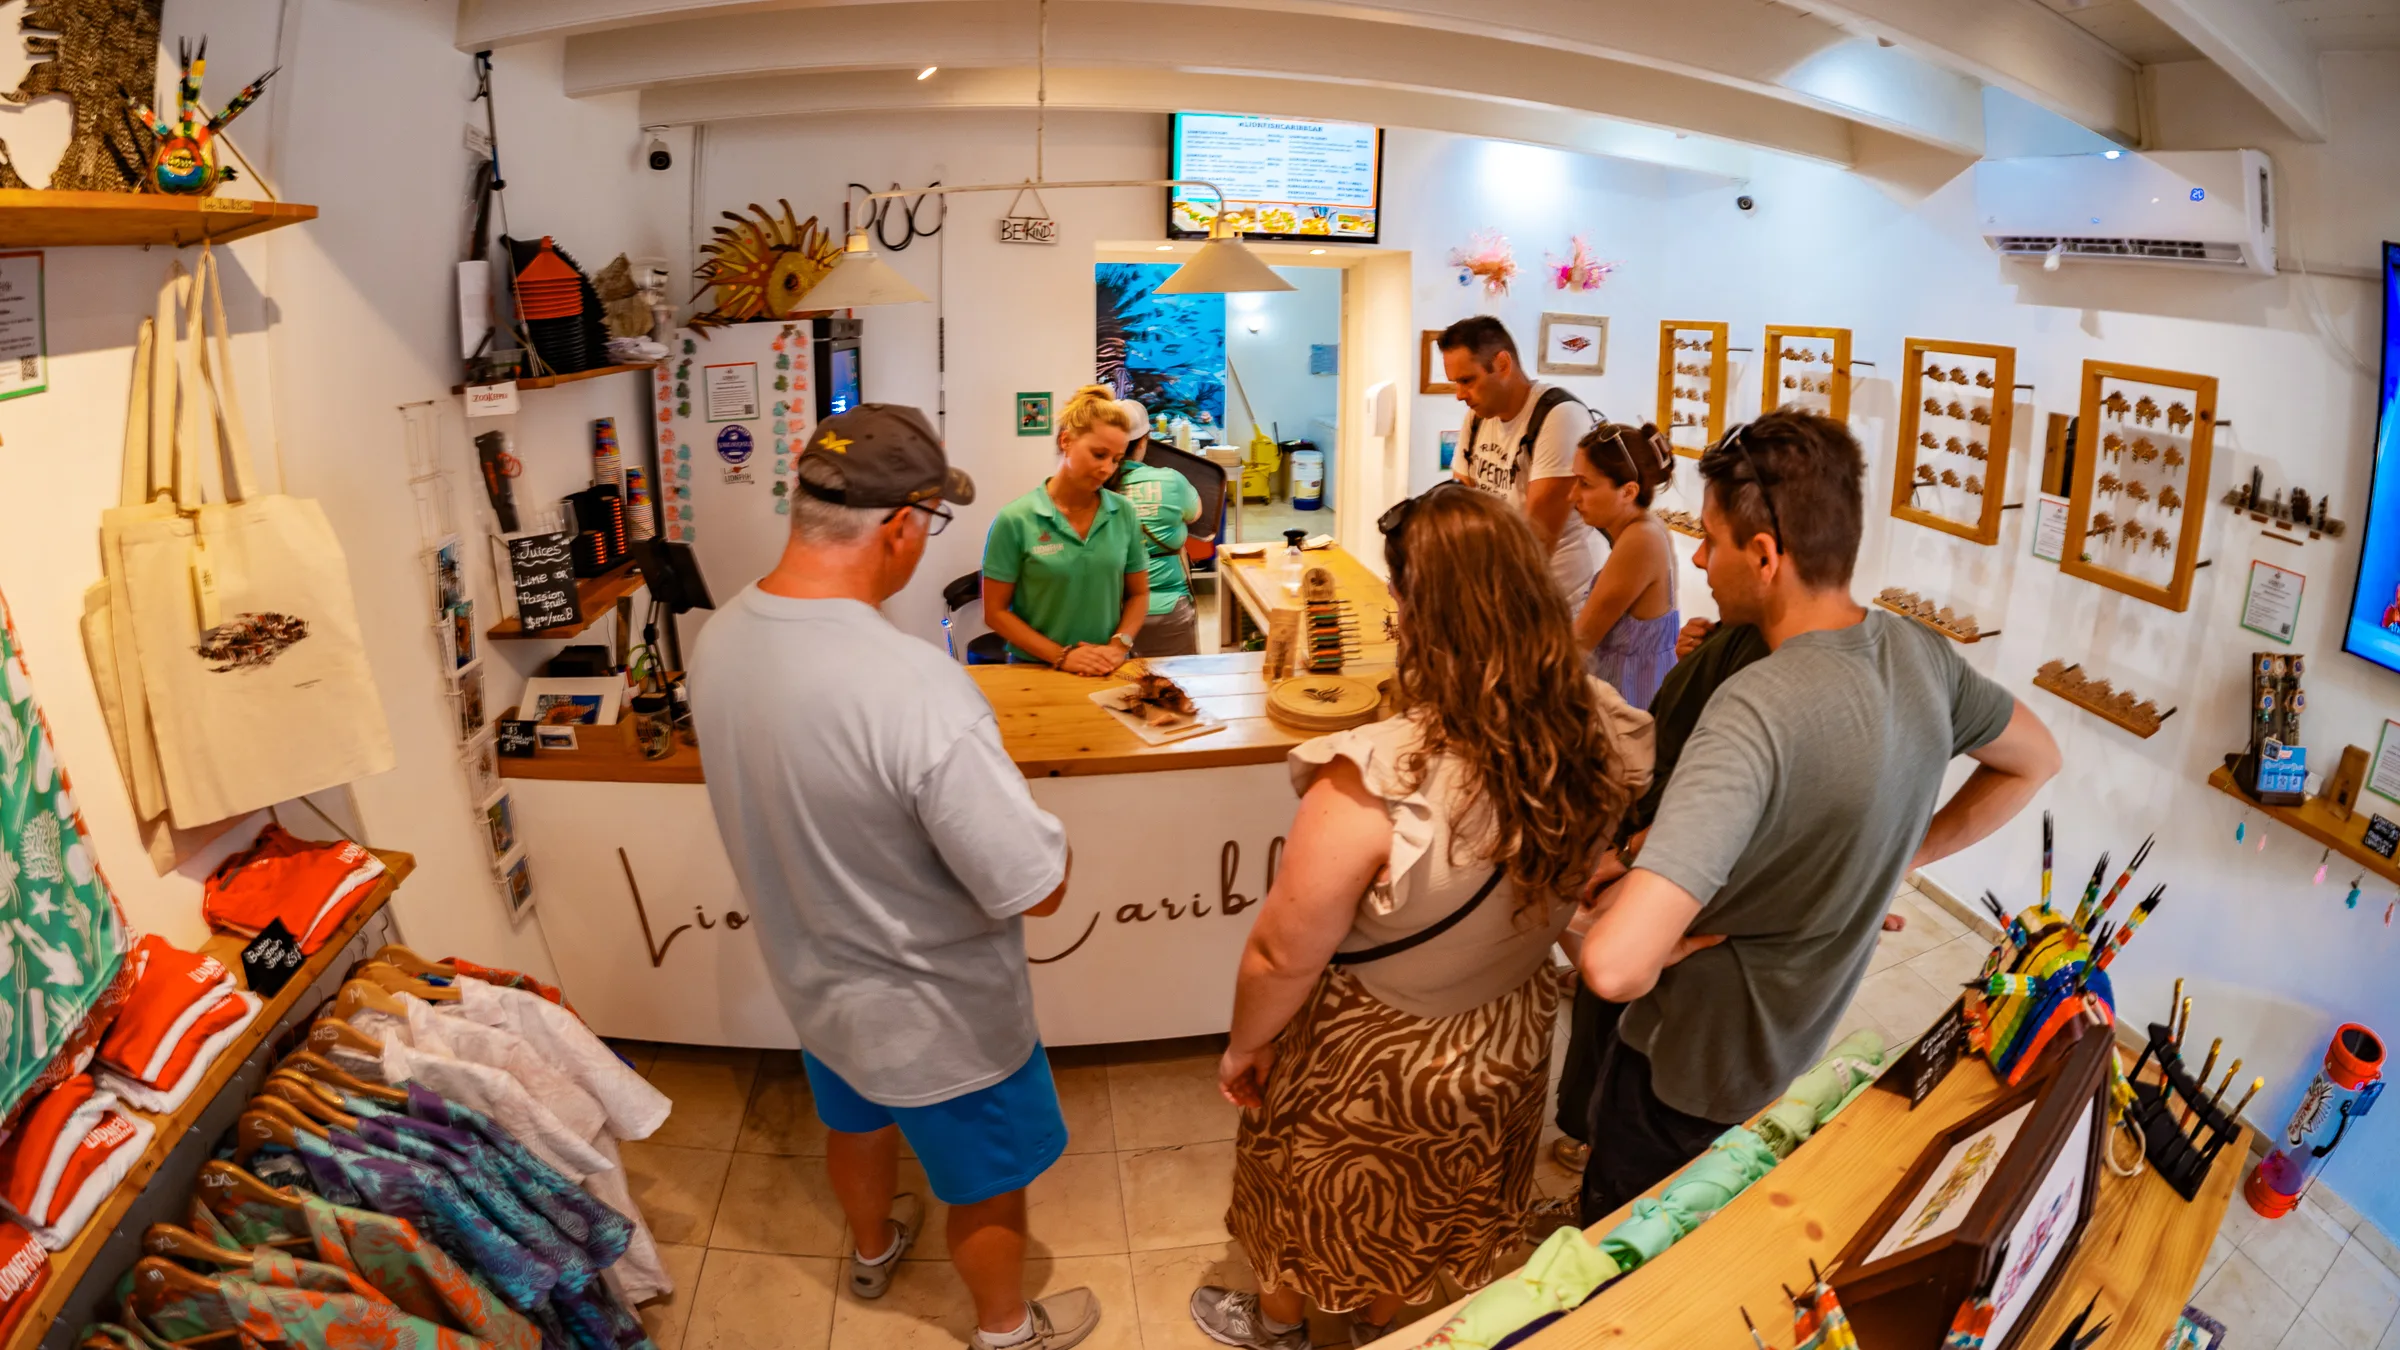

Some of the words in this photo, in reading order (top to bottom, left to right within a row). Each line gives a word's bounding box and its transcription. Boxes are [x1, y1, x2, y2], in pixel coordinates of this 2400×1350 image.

[517, 541, 561, 559] Juices
[522, 590, 565, 604] Passion
[253, 1119, 274, 1139] S
